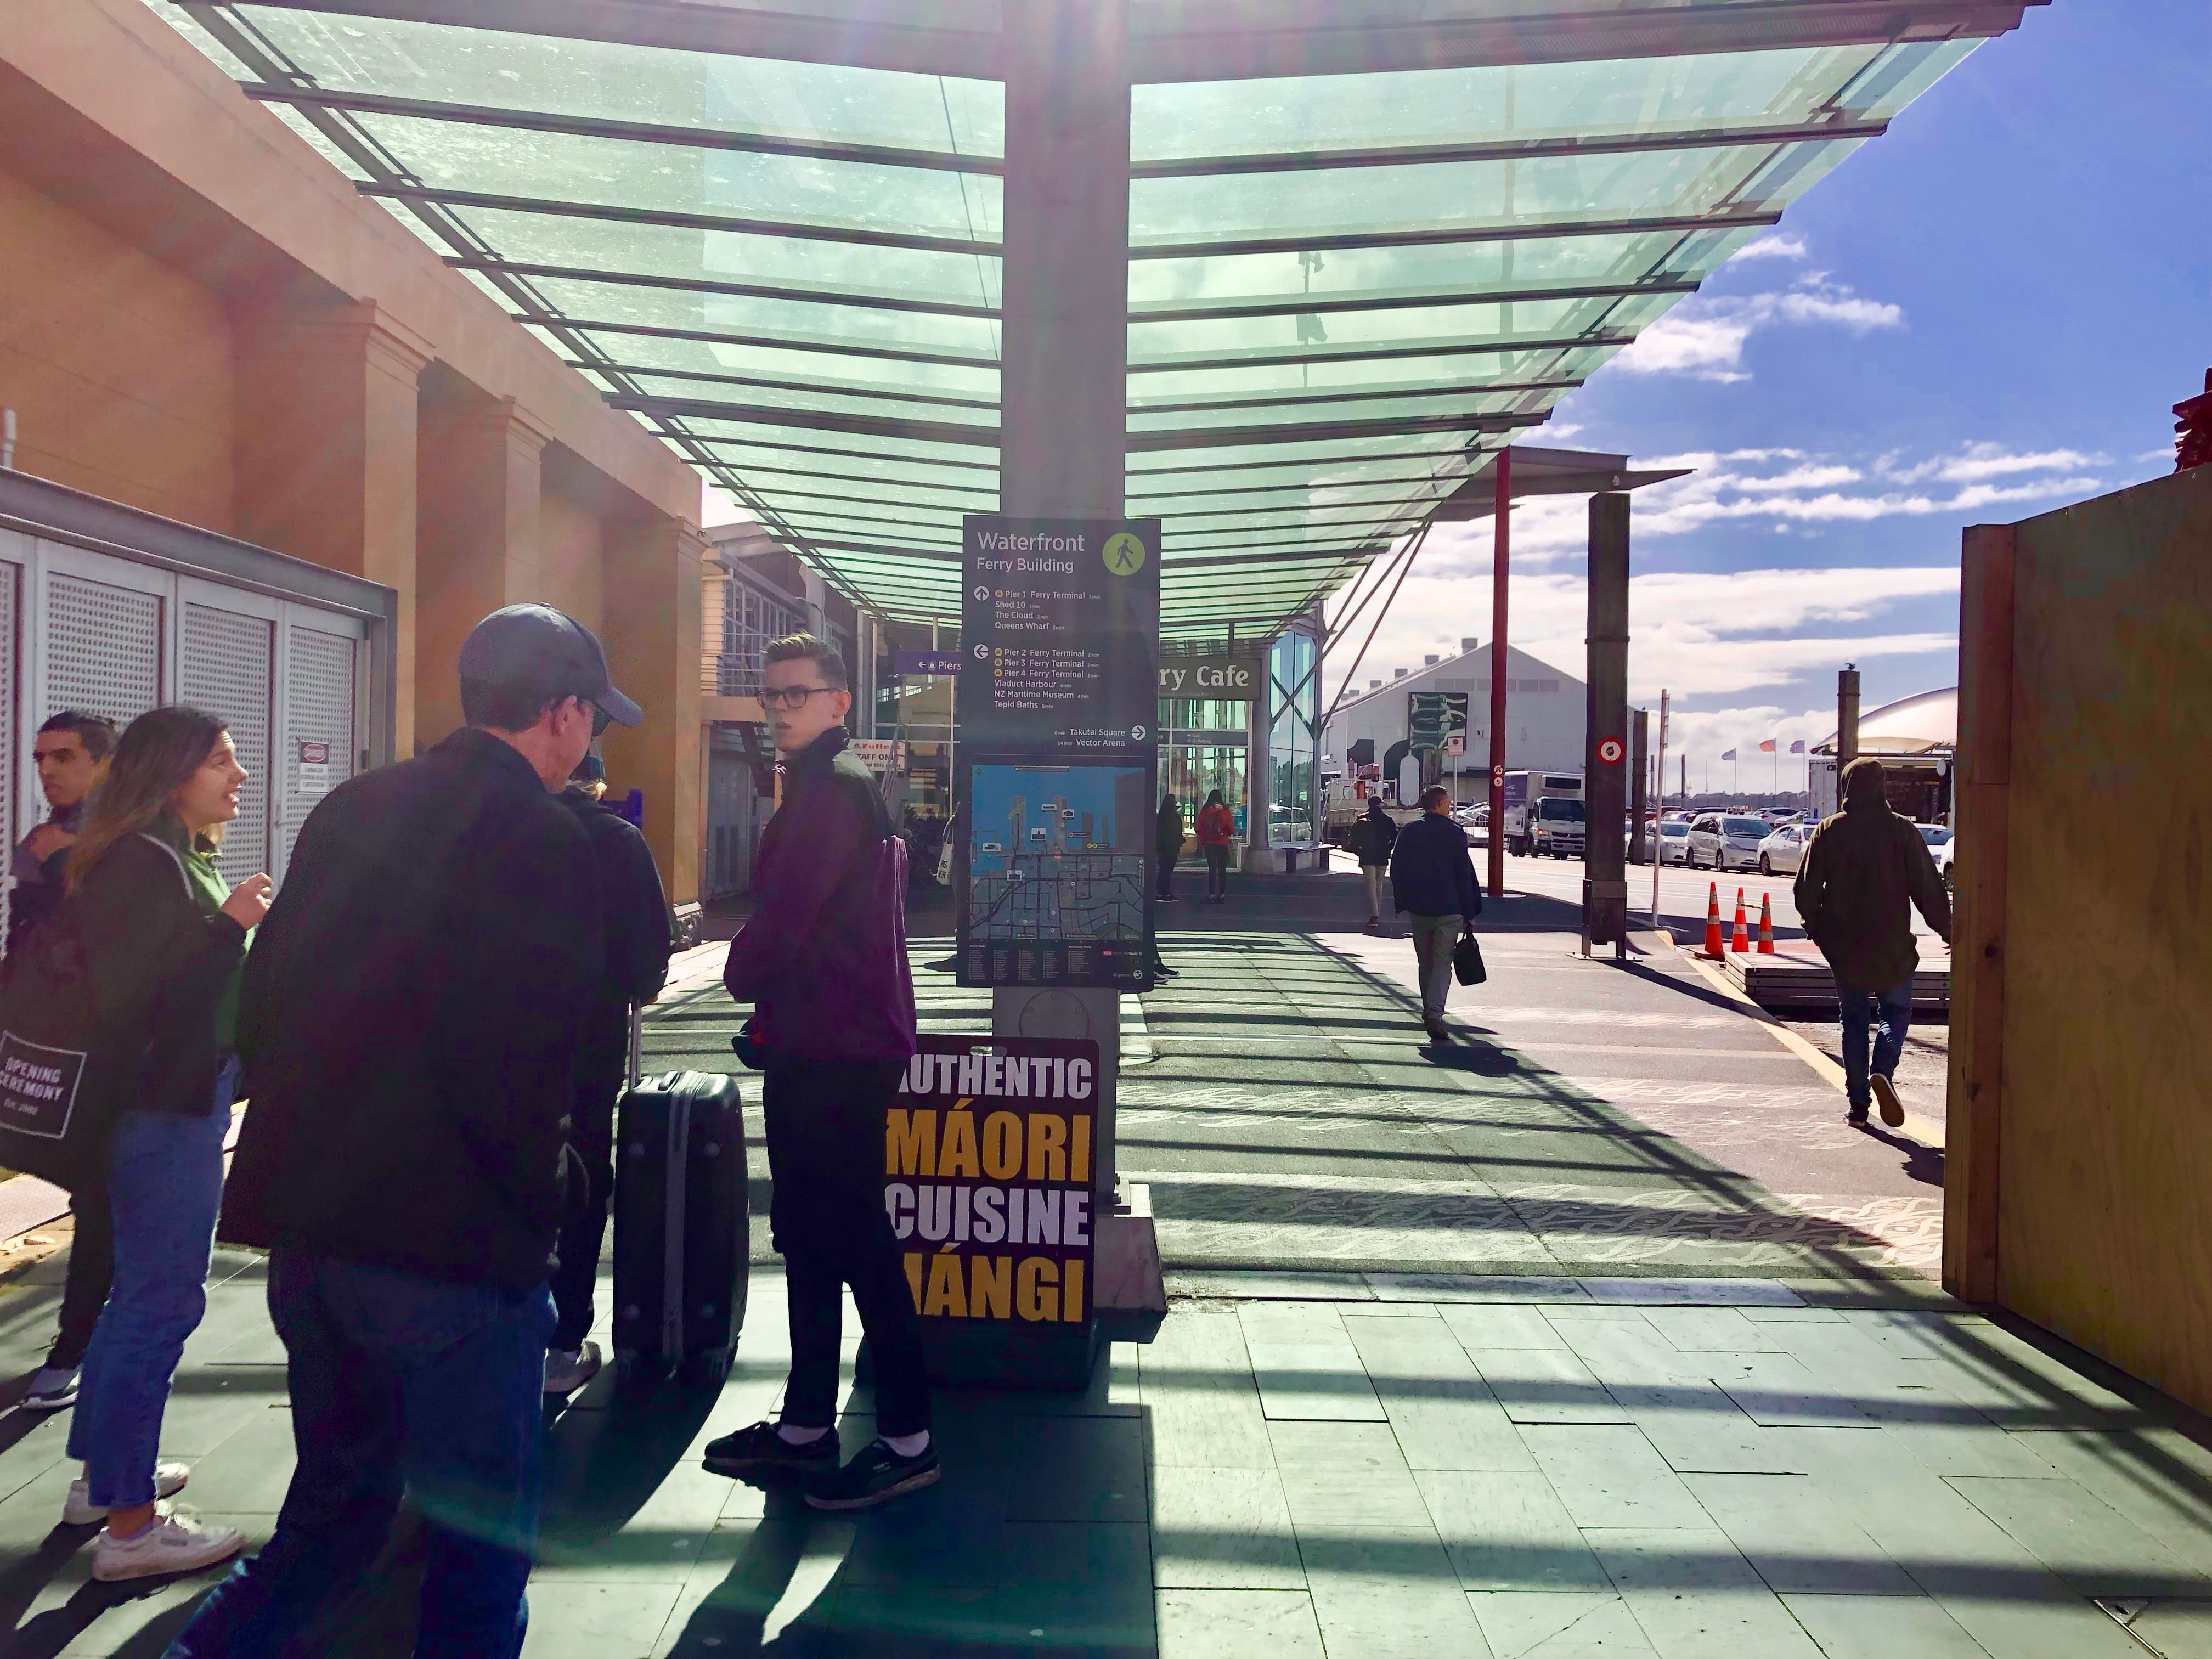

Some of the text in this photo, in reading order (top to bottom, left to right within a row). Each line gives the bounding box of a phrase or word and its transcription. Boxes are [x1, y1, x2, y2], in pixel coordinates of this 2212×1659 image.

[977, 532, 1085, 551] Waterfront
[977, 557, 1074, 574] Ferry Building
[1031, 591, 1051, 600] Ferry
[1053, 591, 1085, 600] Terminal
[938, 661, 962, 670] Piers
[1030, 659, 1049, 668] Ferry
[1029, 670, 1049, 679] Ferry
[1196, 665, 1249, 687] Cafe
[994, 701, 1015, 709] Tepid
[1099, 729, 1125, 737] Square
[885, 1098, 1091, 1182] MÁORI
[885, 1183, 1089, 1246] CUISINE
